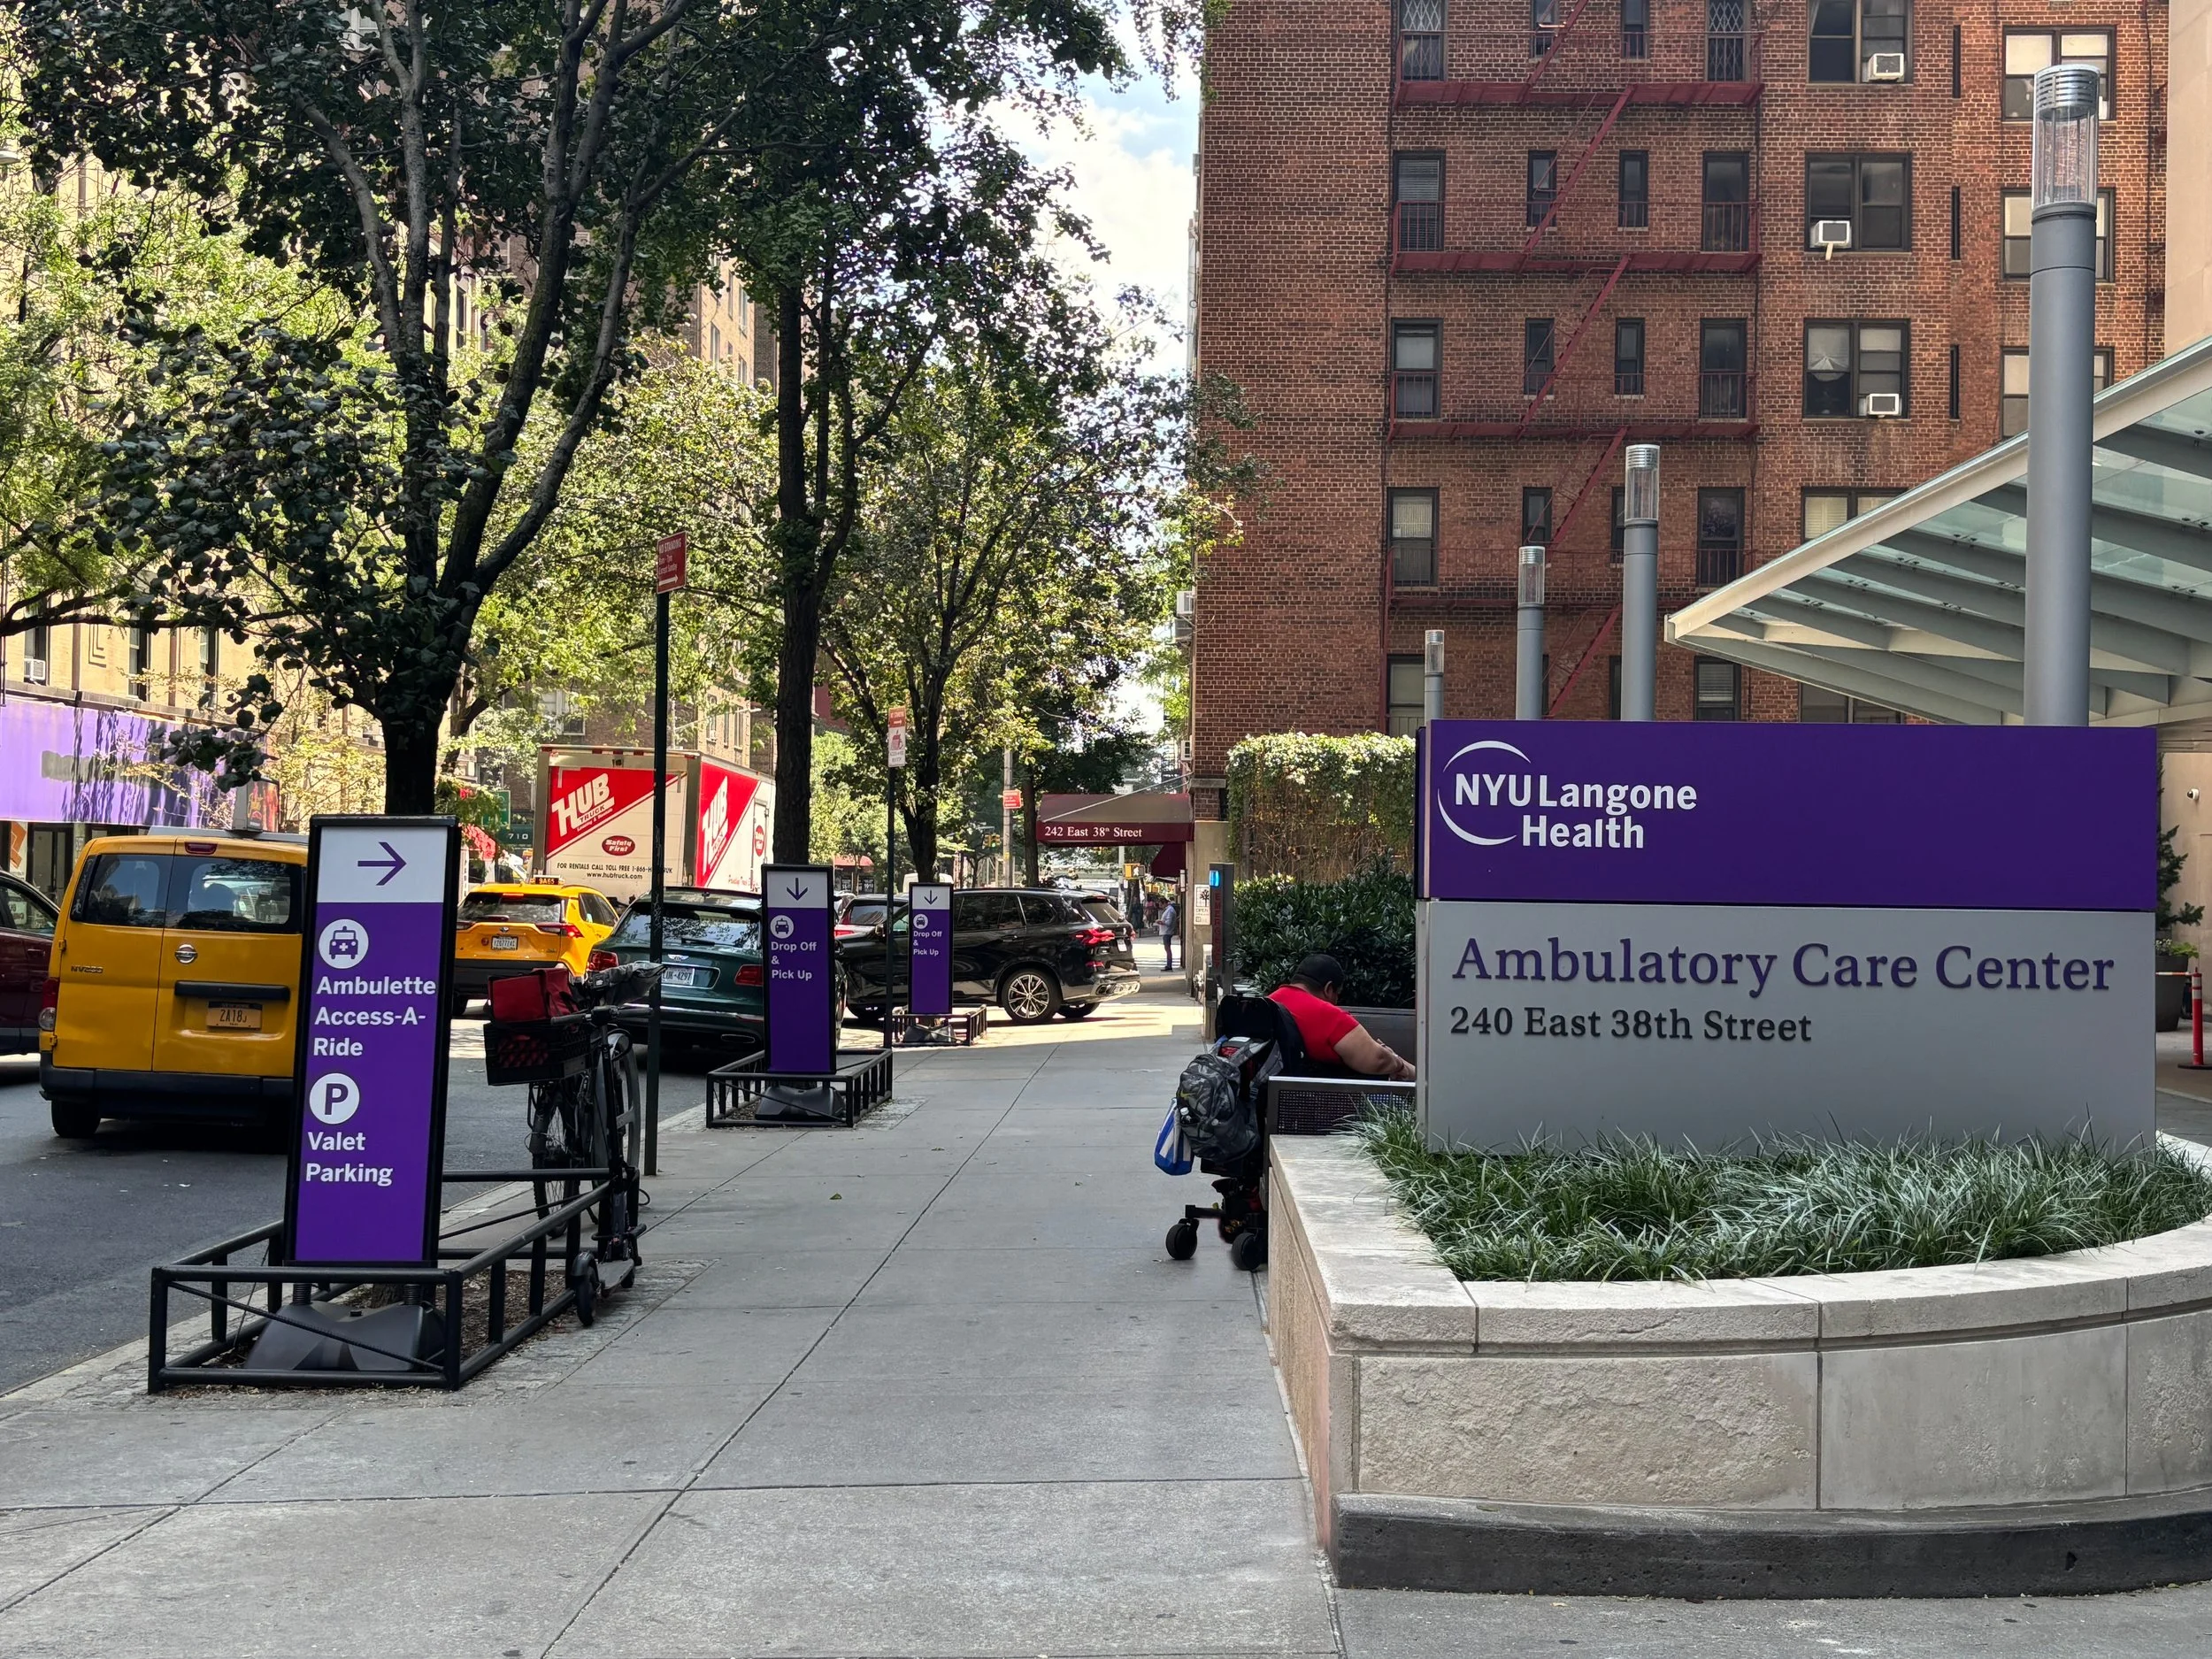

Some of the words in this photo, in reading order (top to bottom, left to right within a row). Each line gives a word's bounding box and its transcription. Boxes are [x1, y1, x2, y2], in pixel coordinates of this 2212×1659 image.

[1455, 772, 1532, 807] NYU
[1539, 774, 1698, 816] Langone
[551, 772, 615, 837] HUB
[580, 804, 605, 823] TRUCK
[702, 775, 728, 876] HUB
[1044, 826, 1064, 837] 242
[1067, 826, 1088, 837] East
[1093, 826, 1110, 837] 38th
[1113, 826, 1142, 838] Street
[1522, 815, 1644, 849] Health
[605, 839, 632, 848] Safety
[586, 872, 643, 880] www.hubtruck.com
[771, 941, 797, 953] Drop
[800, 941, 817, 951] Off
[771, 955, 780, 964] &
[1452, 937, 1778, 998] Ambulatory
[1793, 942, 1918, 988] Care
[1935, 945, 2115, 992] Center
[772, 969, 795, 979] Pick
[797, 970, 813, 981] Up
[316, 976, 436, 995] Ambulette
[314, 1007, 426, 1025] Access-A-
[1449, 1006, 1514, 1036] 240
[1524, 1007, 1601, 1037] East
[1610, 1009, 1693, 1041] 38th
[1703, 1010, 1813, 1042] Street
[313, 1038, 364, 1056] Ride
[324, 1083, 349, 1116] P
[308, 1131, 366, 1151] Valet
[305, 1163, 394, 1187] Parking
